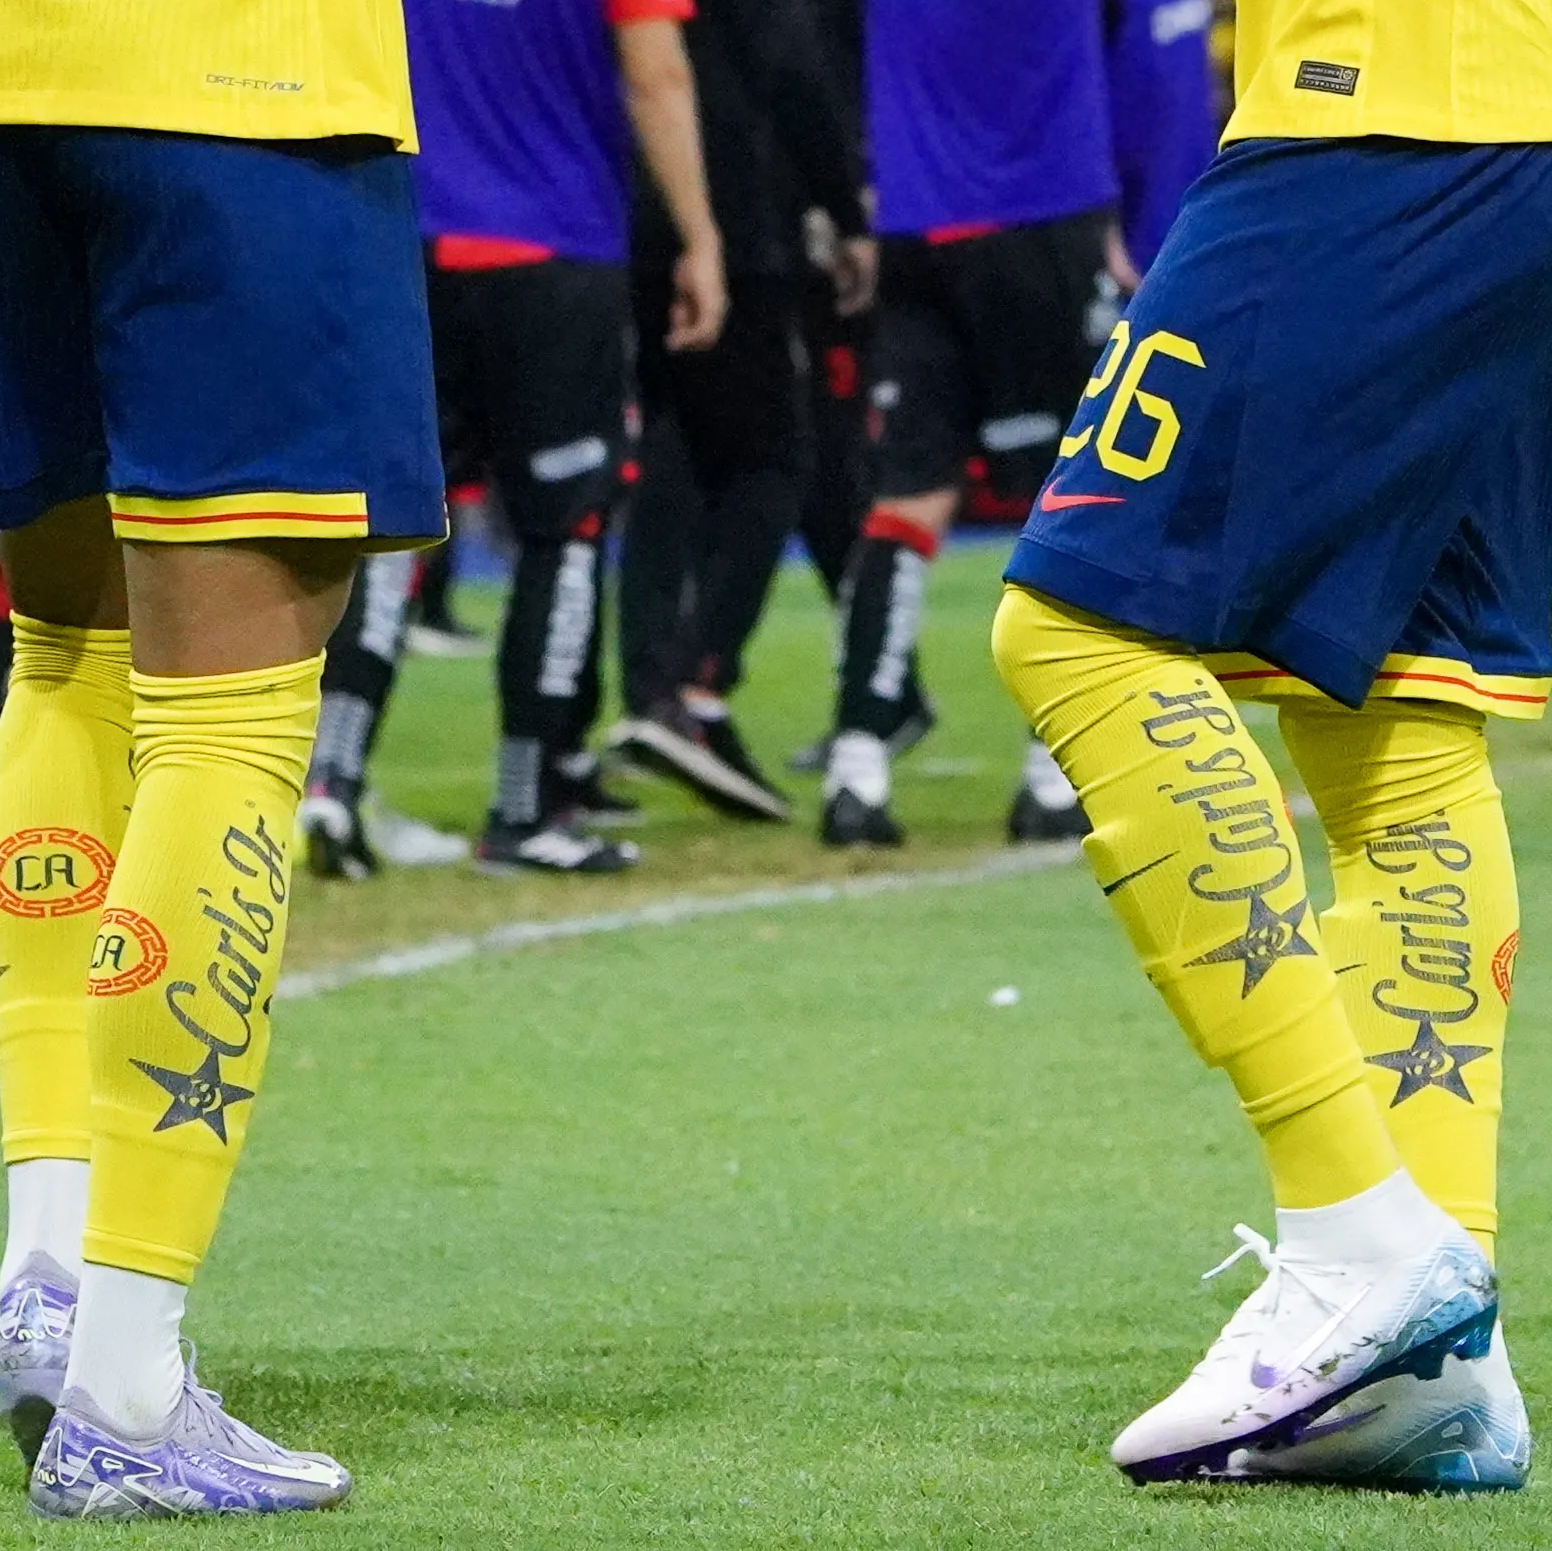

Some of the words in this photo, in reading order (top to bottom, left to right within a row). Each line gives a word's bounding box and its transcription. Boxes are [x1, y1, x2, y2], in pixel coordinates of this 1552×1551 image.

[1057, 319, 1208, 482] 26
[1139, 677, 1237, 749] Jr.
[15, 852, 80, 893] CA
[1156, 746, 1294, 903] Carl's
[1365, 808, 1473, 875] Jr.
[165, 886, 276, 1059] Carl's
[221, 813, 287, 905] Jr.
[1371, 882, 1480, 1025] Carl's
